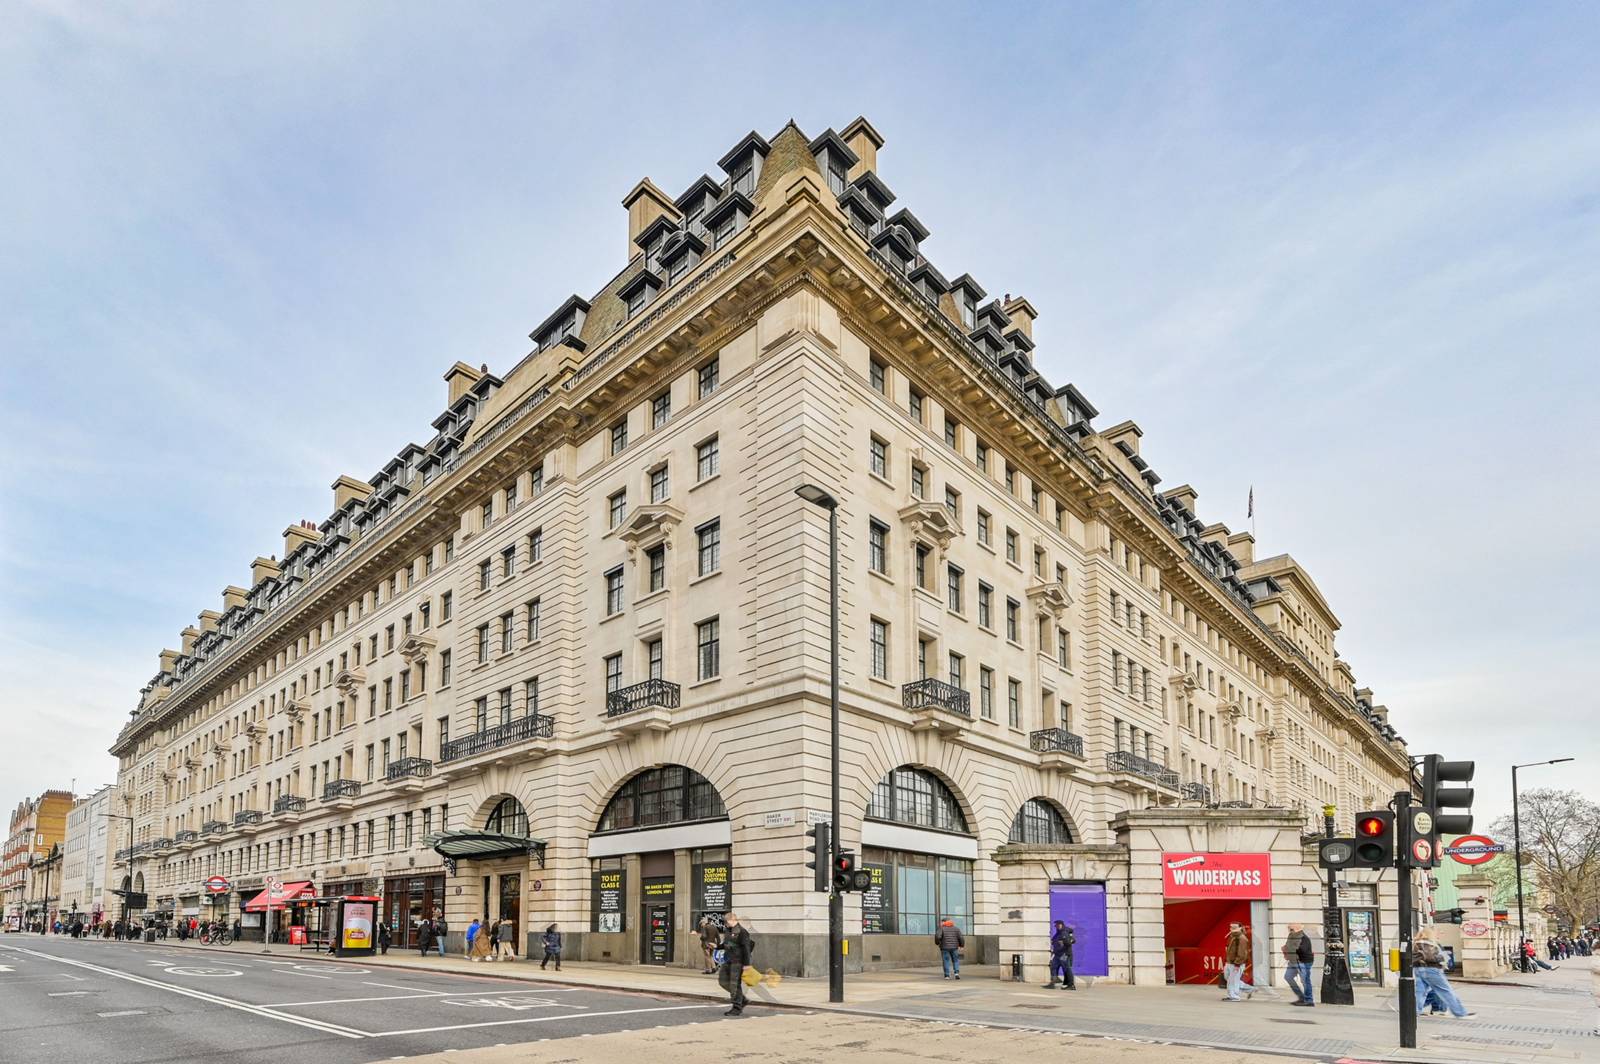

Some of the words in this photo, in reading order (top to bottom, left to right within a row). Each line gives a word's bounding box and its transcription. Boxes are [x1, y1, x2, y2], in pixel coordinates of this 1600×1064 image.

[1445, 846, 1502, 854] UNDERGROUND
[1210, 860, 1223, 868] The
[871, 868, 882, 876] LET
[610, 874, 621, 882] LET
[1173, 870, 1261, 886] WONDERPASS
[1203, 955, 1224, 970] STA
